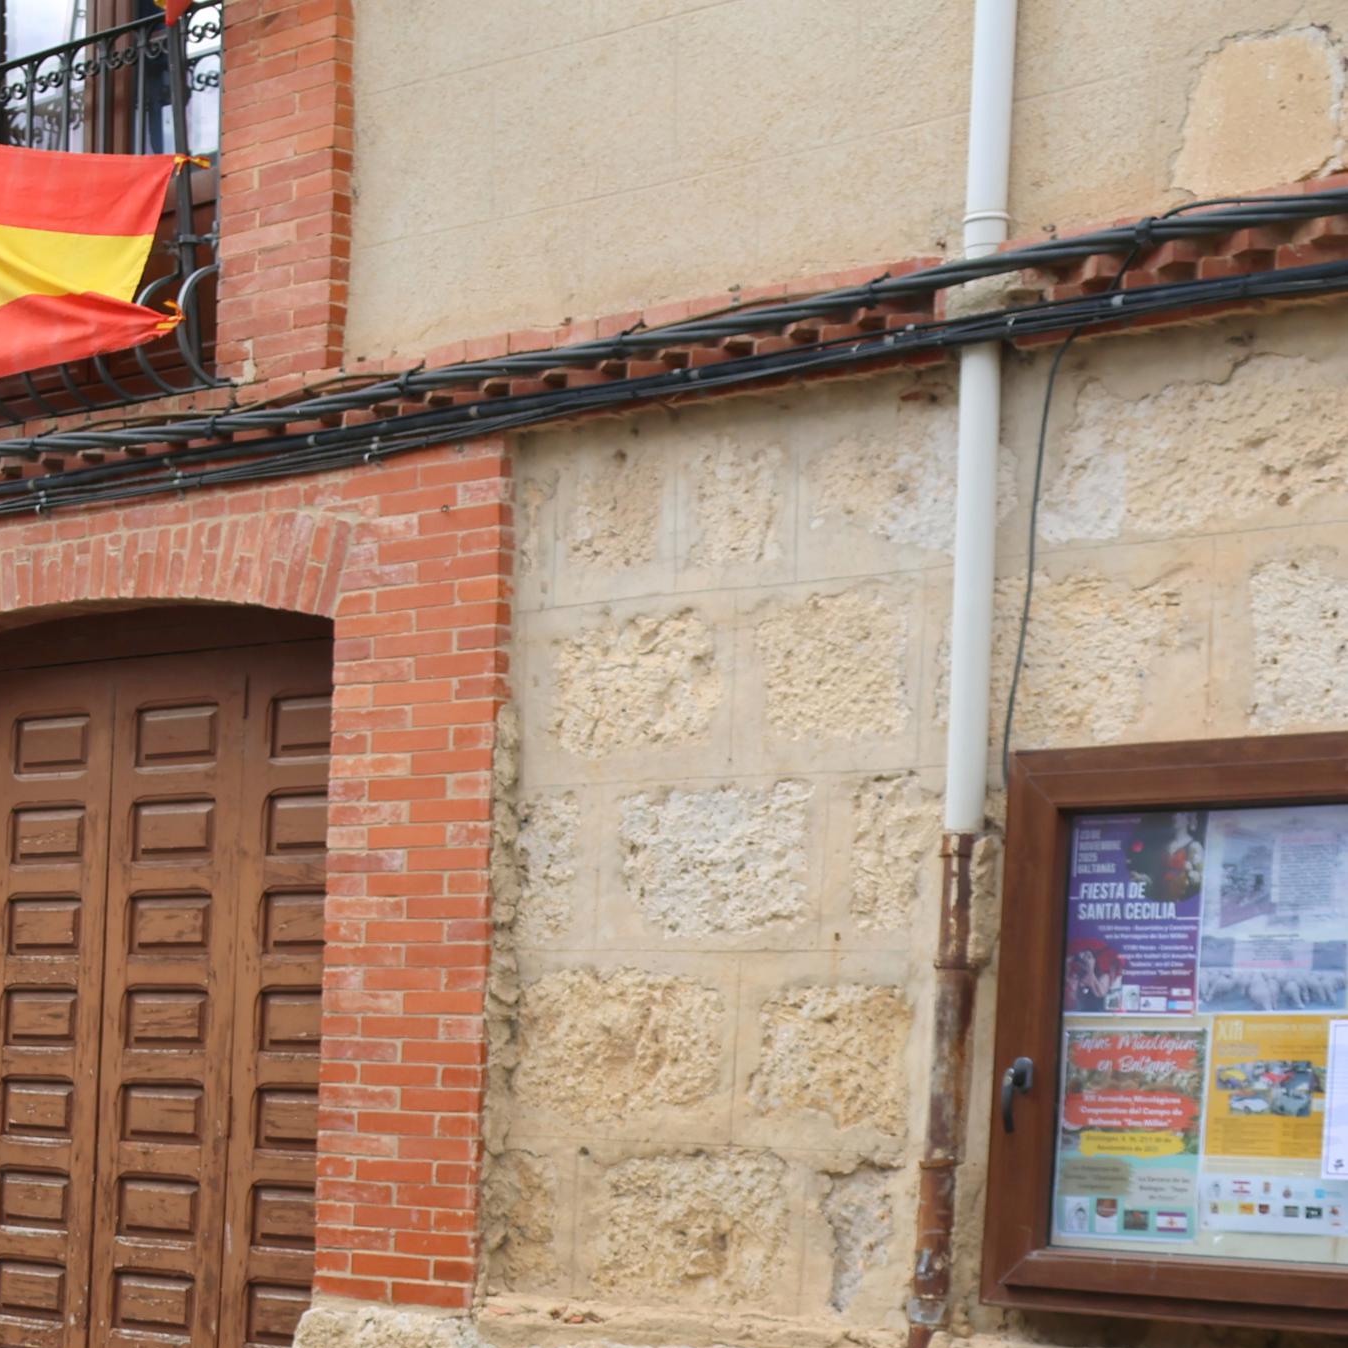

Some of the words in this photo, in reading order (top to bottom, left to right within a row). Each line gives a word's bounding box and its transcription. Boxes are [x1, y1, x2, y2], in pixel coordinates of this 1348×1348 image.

[1079, 881, 1125, 899] FIESTA
[1128, 881, 1146, 899] DE
[1077, 901, 1122, 920] SANTA
[1124, 901, 1177, 920] CECILIA
